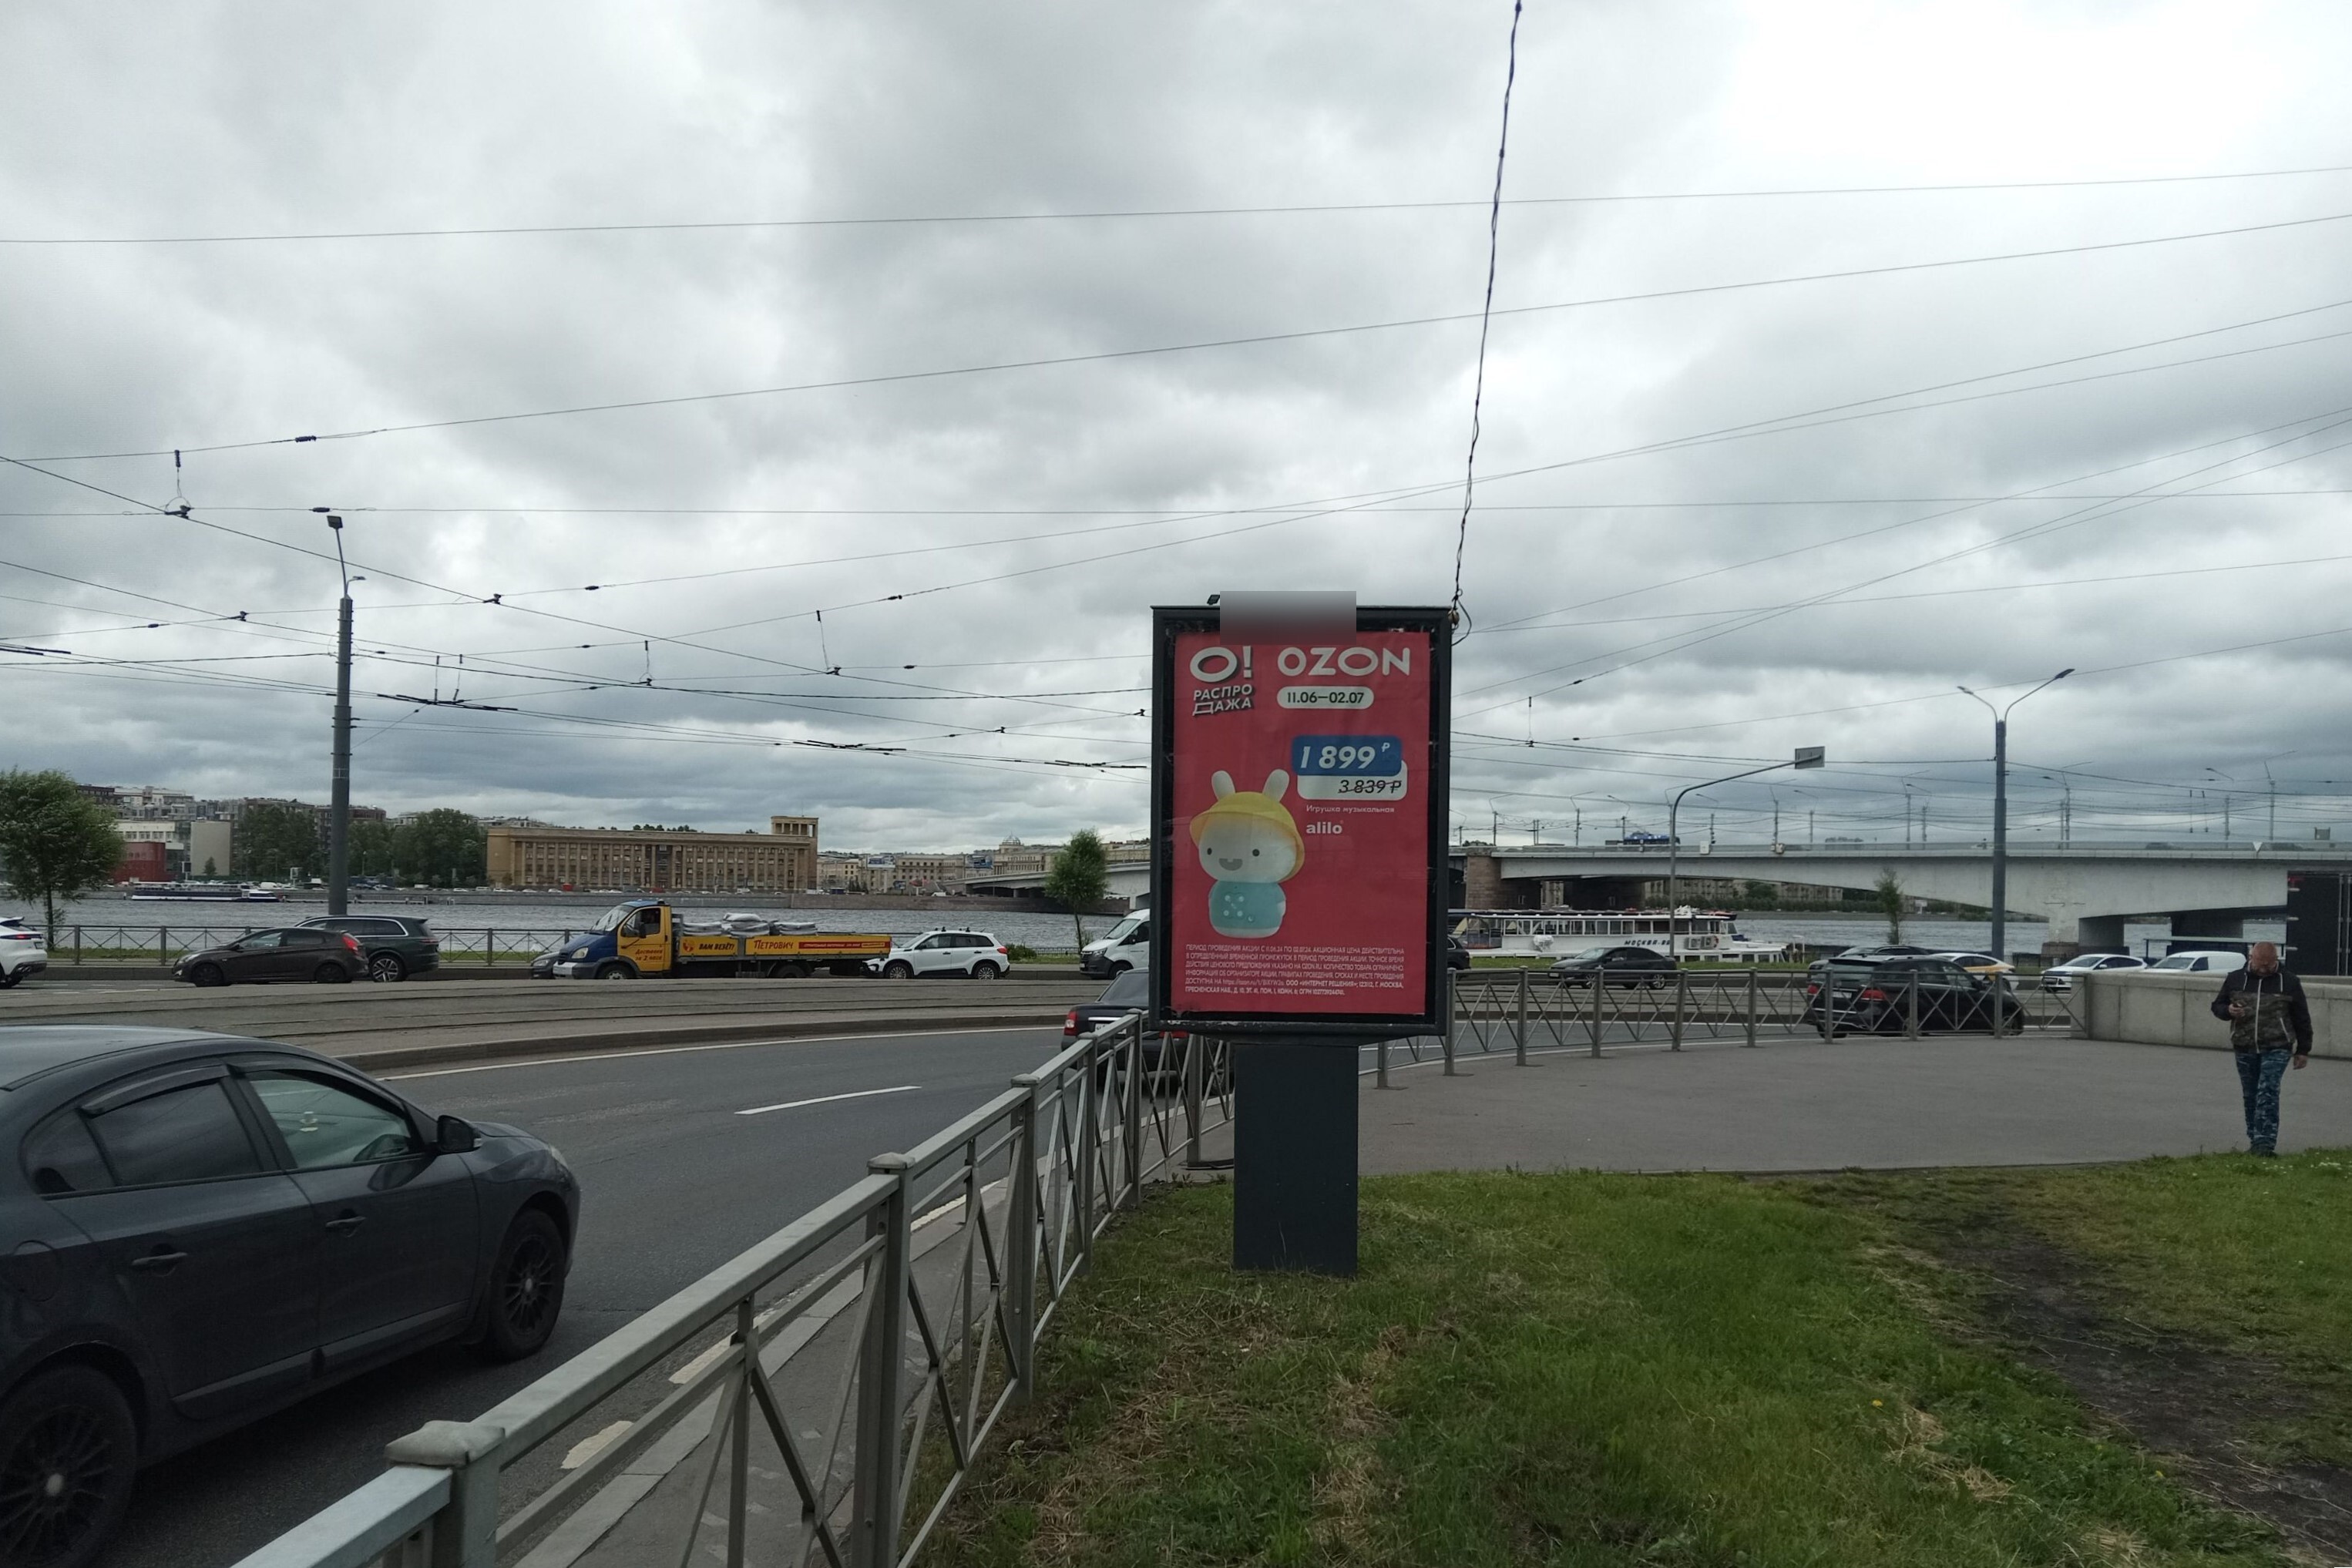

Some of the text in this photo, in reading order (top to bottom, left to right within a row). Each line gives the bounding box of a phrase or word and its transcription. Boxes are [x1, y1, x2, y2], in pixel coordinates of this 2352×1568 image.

[1277, 646, 1410, 677] OZON
[1193, 683, 1252, 701] РАСПРО
[1191, 697, 1252, 717] ДАЖА
[1319, 745, 1376, 769] 899
[1305, 804, 1395, 814] Игрушка музыкальная
[1305, 821, 1342, 834] alilo
[698, 942, 714, 951] ВАМ
